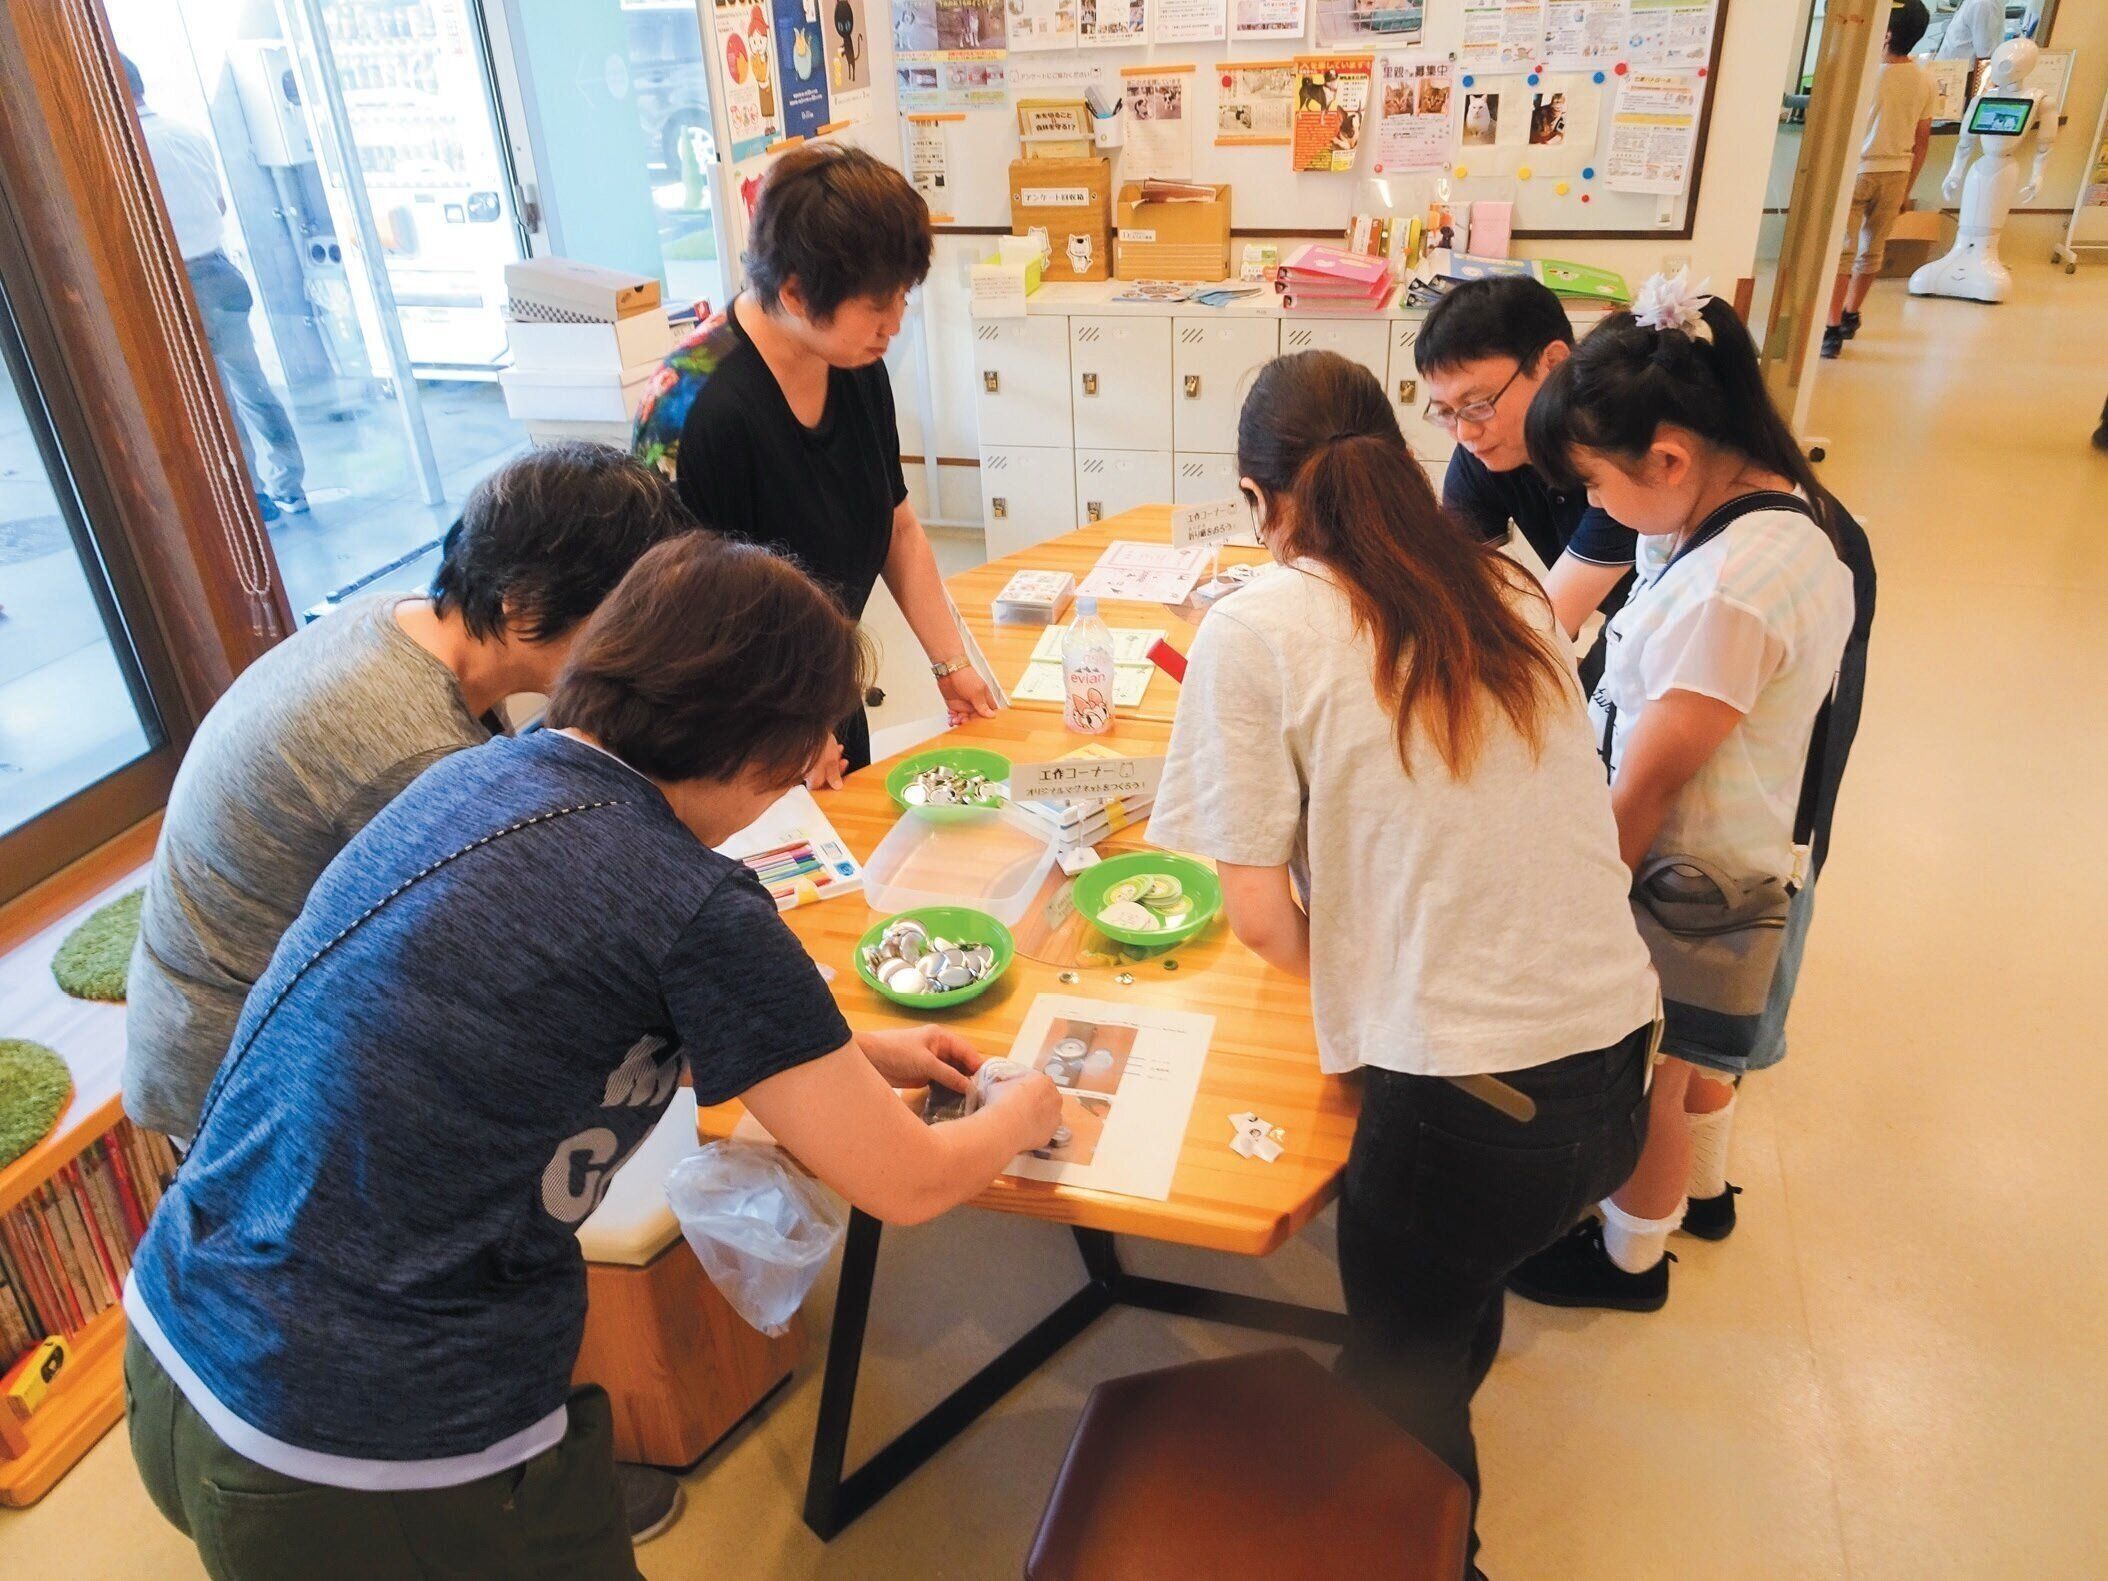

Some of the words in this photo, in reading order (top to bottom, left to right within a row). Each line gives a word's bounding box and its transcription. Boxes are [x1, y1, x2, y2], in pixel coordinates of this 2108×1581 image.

[1071, 673, 1106, 684] evian
[1040, 766, 1114, 780] 工作コーナー
